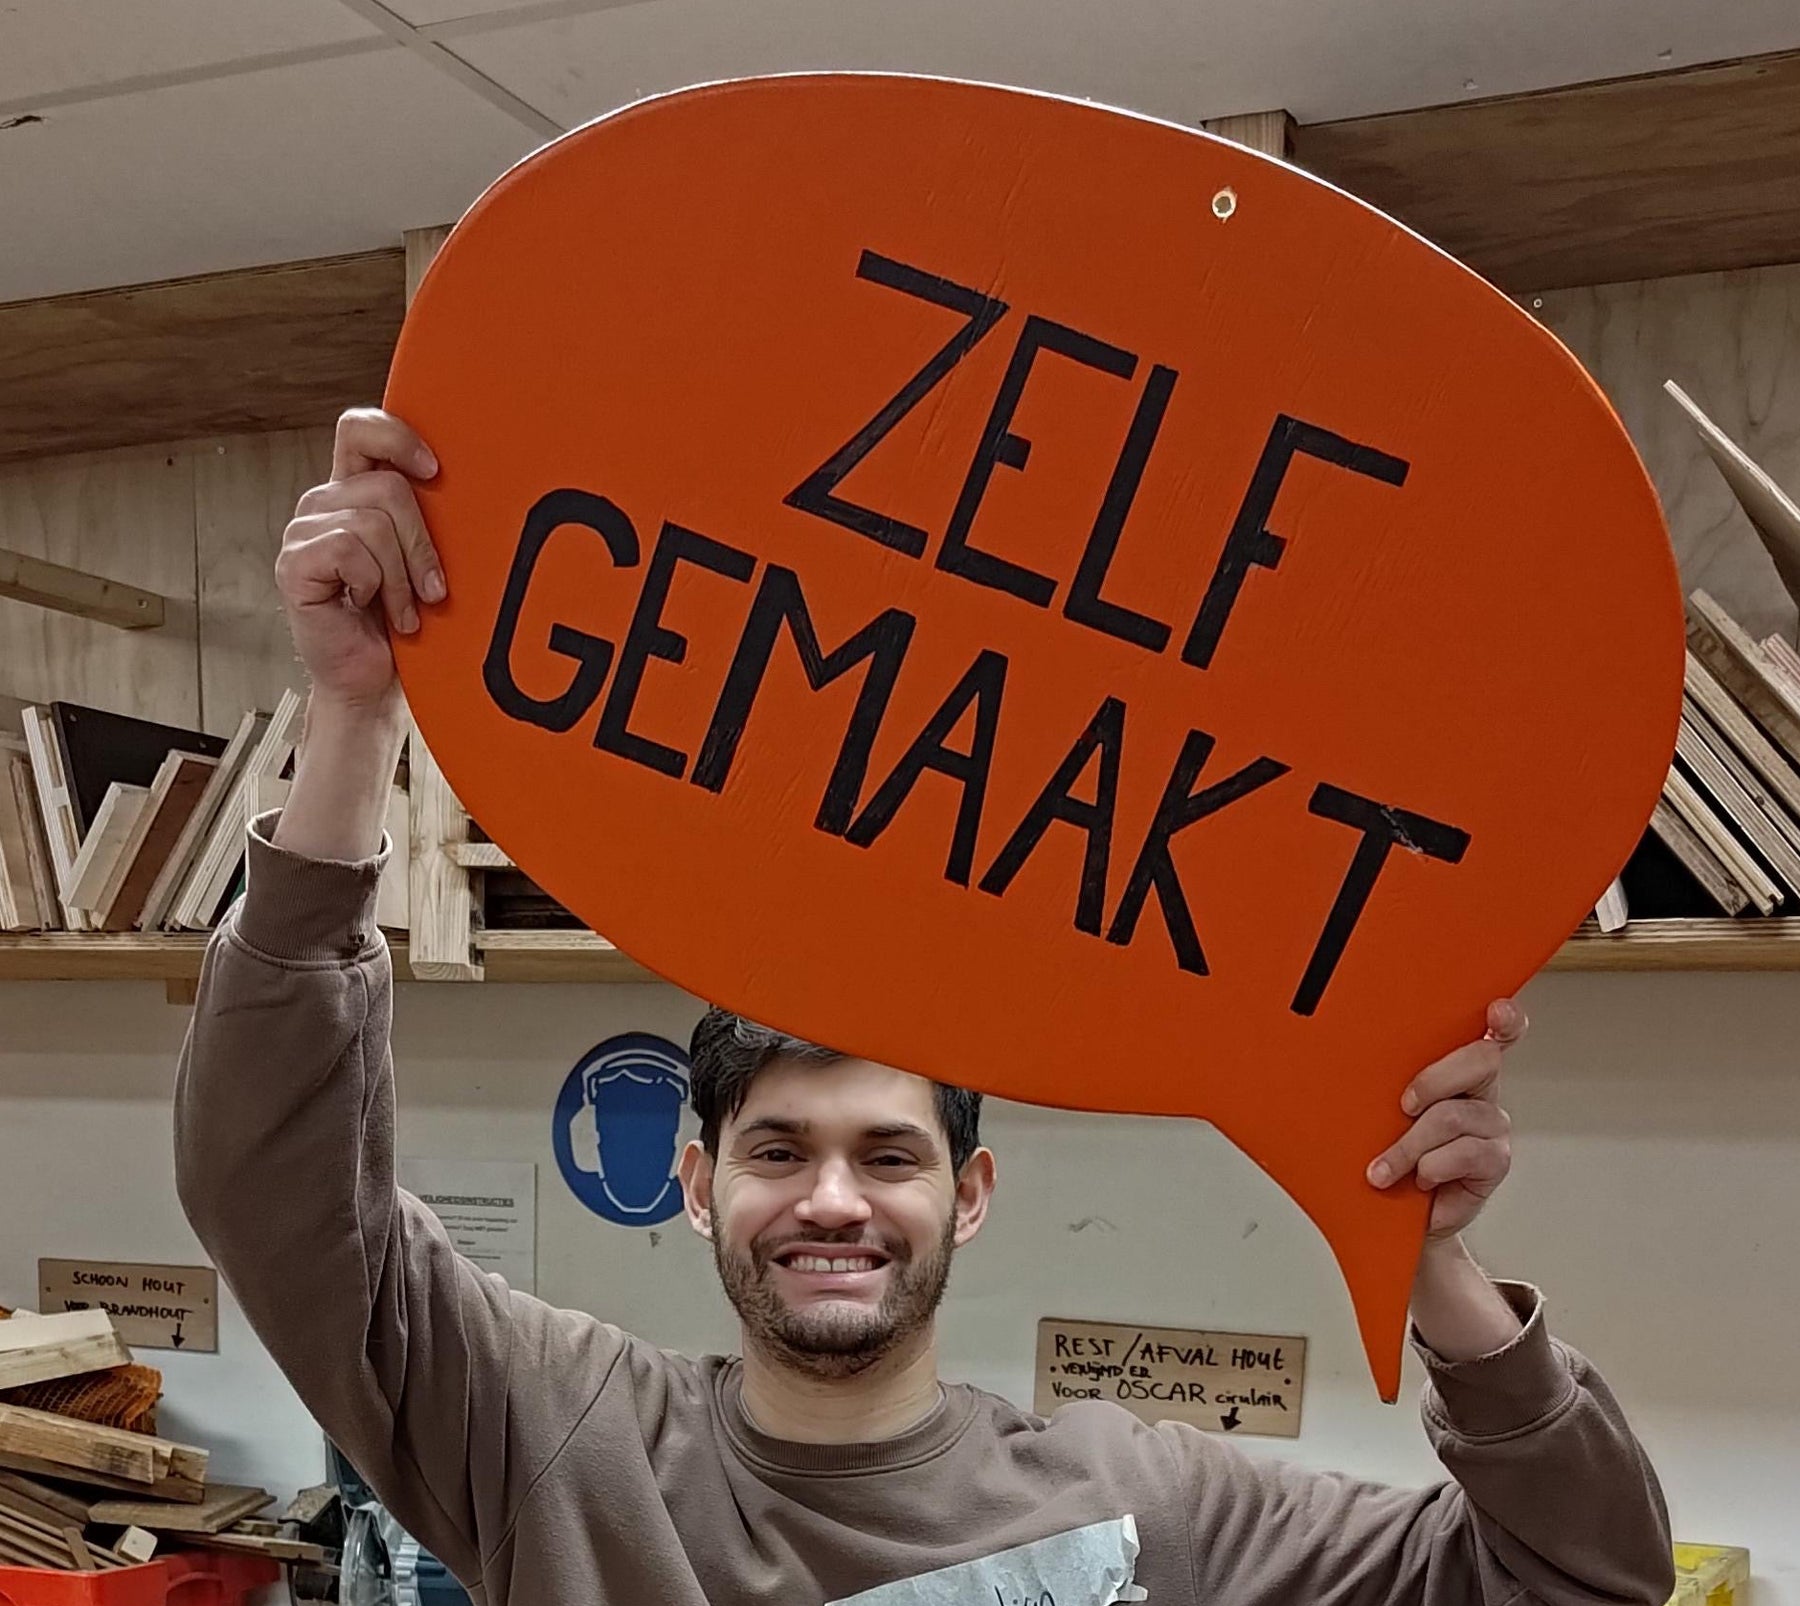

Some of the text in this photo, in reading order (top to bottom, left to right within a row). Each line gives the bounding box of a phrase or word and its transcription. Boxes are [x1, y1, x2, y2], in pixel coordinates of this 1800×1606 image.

[783, 249, 1410, 670] ZELF
[482, 488, 1471, 1016] GEMAAKT
[72, 1271, 187, 1296] SCHOON HOUT
[99, 1301, 194, 1321] BRANDHOUT
[1054, 1334, 1115, 1357] REST
[1117, 1379, 1207, 1405] OSCAR
